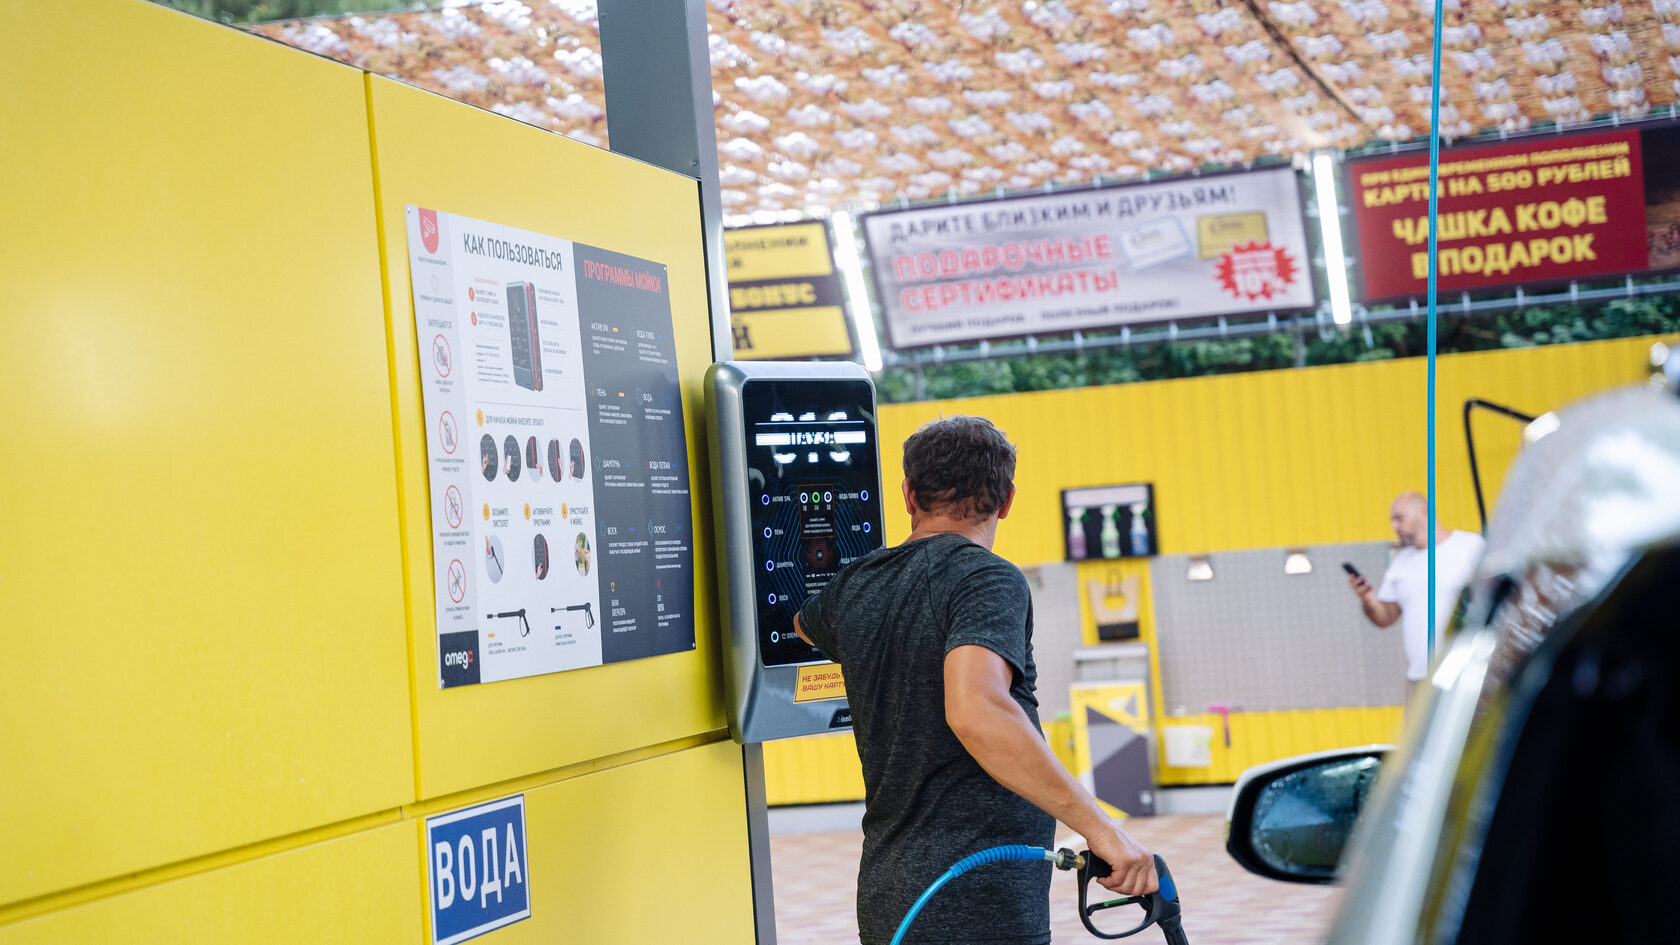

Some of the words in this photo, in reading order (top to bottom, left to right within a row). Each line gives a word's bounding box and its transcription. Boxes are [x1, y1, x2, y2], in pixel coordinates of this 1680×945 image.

[1392, 153, 1528, 183] ЕДИНВРЕМЕННОМ
[1448, 175, 1483, 197] НА
[1486, 169, 1533, 193] 500
[1537, 153, 1631, 187] РУБЛЕЙ
[890, 213, 973, 244] ДАРИТЕ
[983, 203, 1090, 229] БЛИЗКИМ
[1099, 198, 1112, 216] И
[1117, 185, 1237, 219] ДРУЗЬЯМ!
[1392, 206, 1512, 245] ЧАШКА
[1515, 195, 1608, 233] КОФЕ
[463, 232, 486, 256] КАК
[487, 238, 562, 271] ПОЛЬЗОВАТЬСЯ
[893, 234, 1113, 283] ПОДАРОЧНЫЕ
[1411, 250, 1430, 279] В
[1438, 233, 1597, 277] ПОДАРОК
[584, 260, 634, 288] ПРОГРАММЫ
[635, 270, 662, 293] МОЙКИ
[730, 282, 817, 309] БОНУС
[901, 269, 1119, 313] СЕРТИФИКАТЫ
[436, 822, 522, 910] ВОДА
